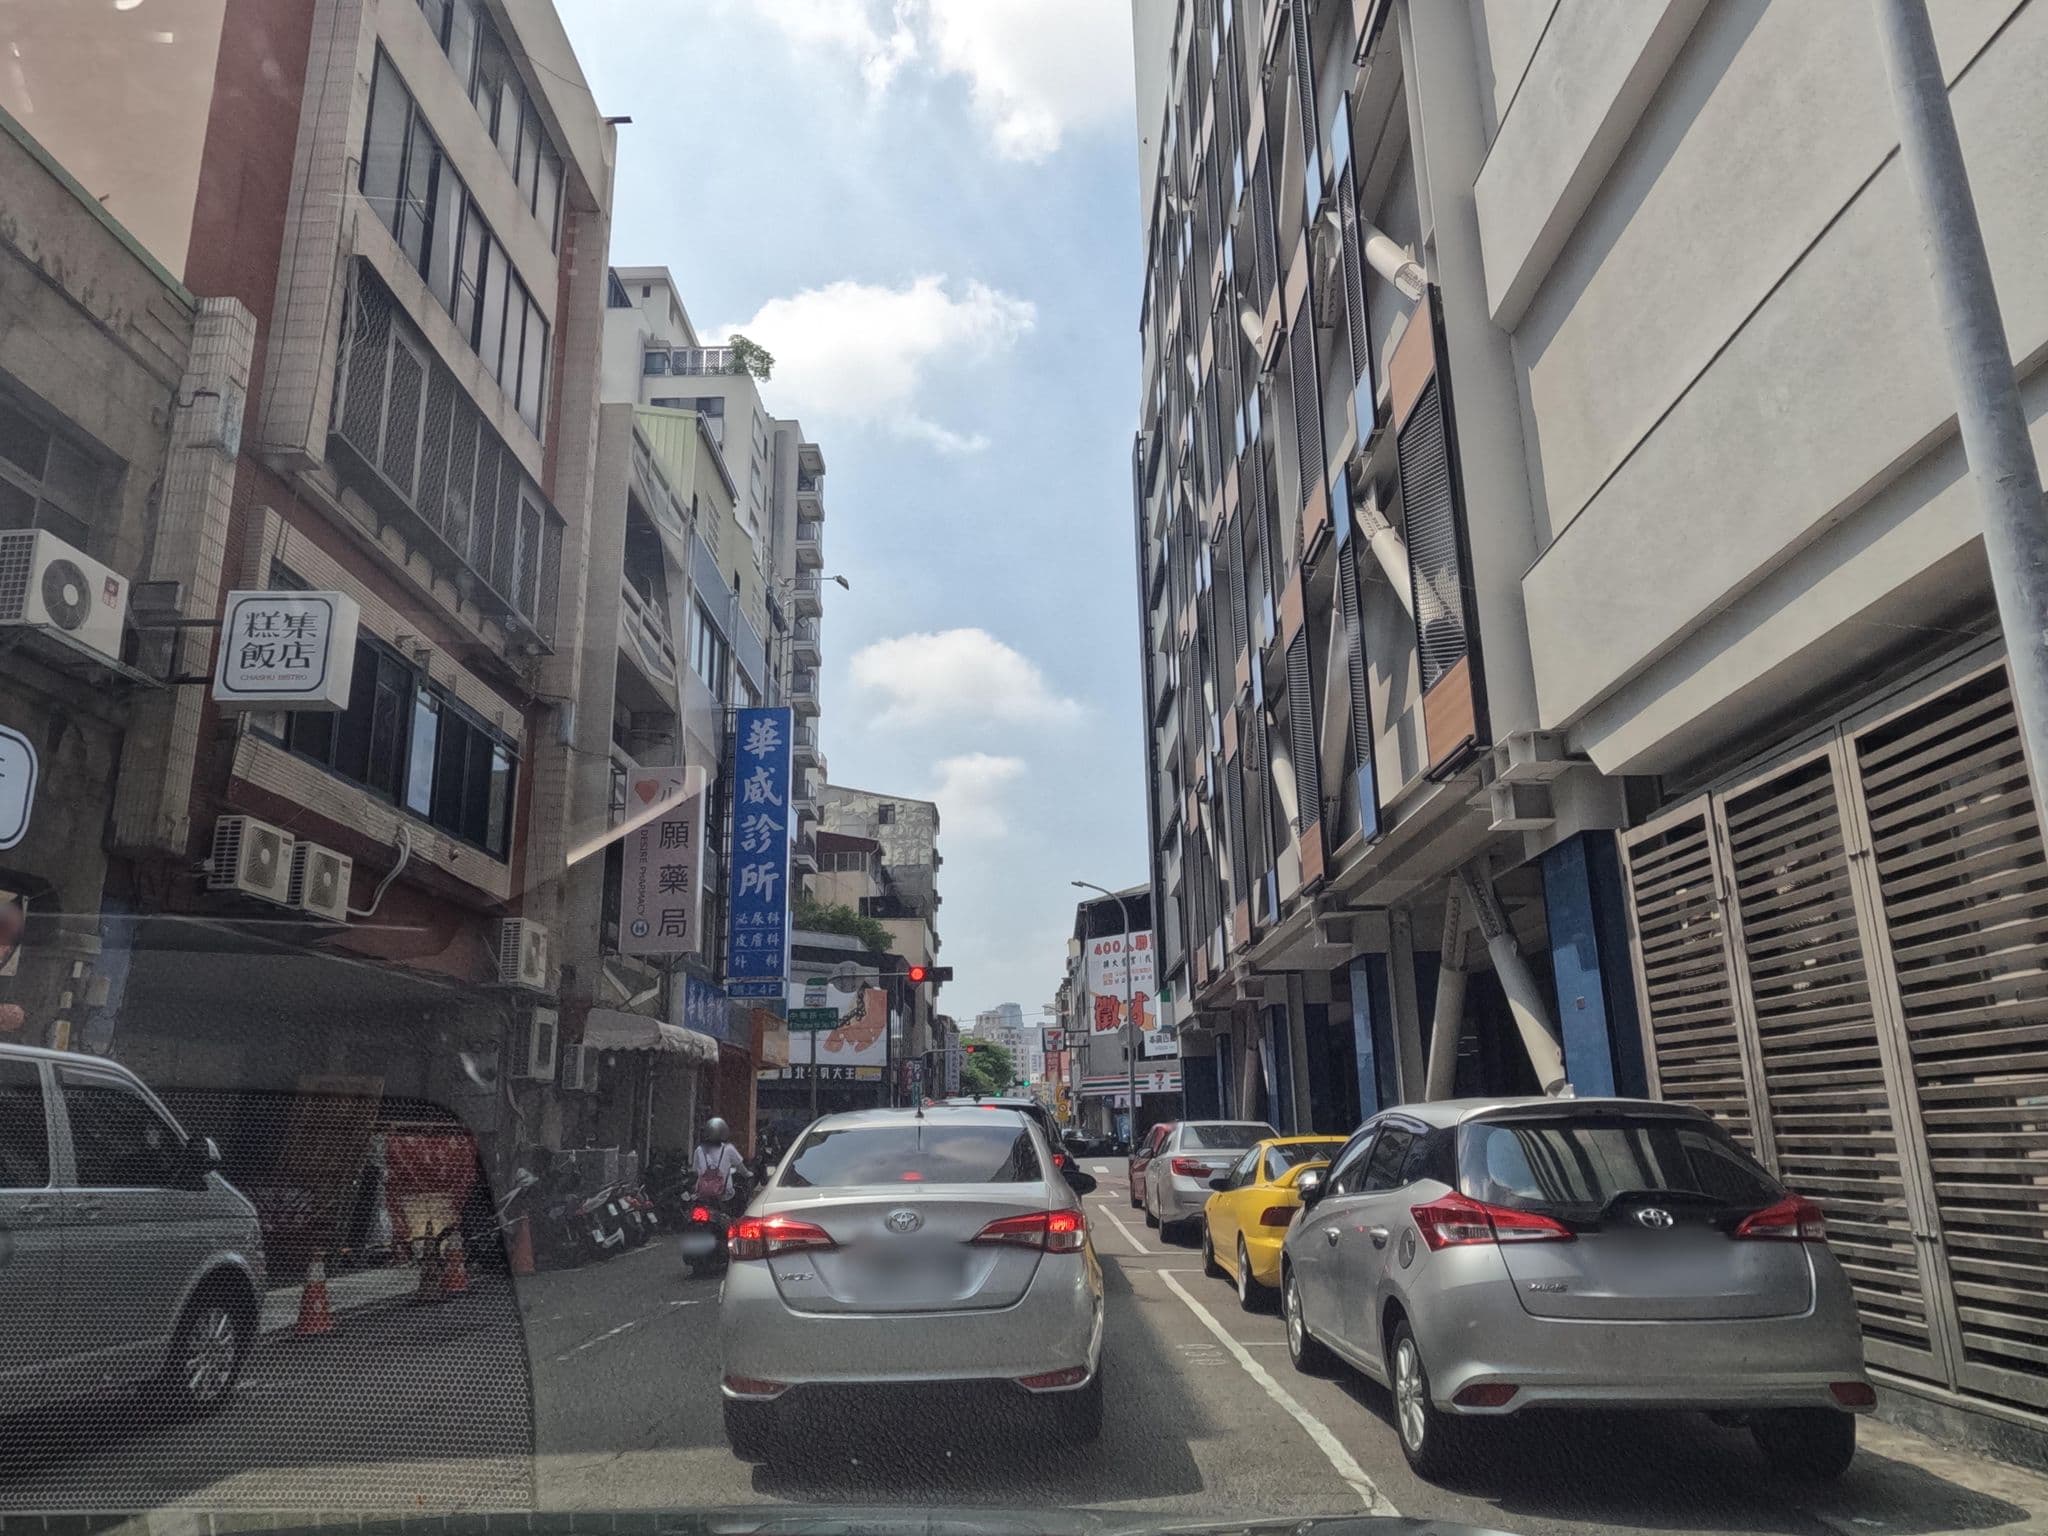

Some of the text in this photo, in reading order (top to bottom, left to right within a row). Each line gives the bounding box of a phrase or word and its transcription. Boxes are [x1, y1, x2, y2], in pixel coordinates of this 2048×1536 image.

[240, 641, 316, 669] 飯店
[635, 829, 649, 916] DESIRE PHARMACY
